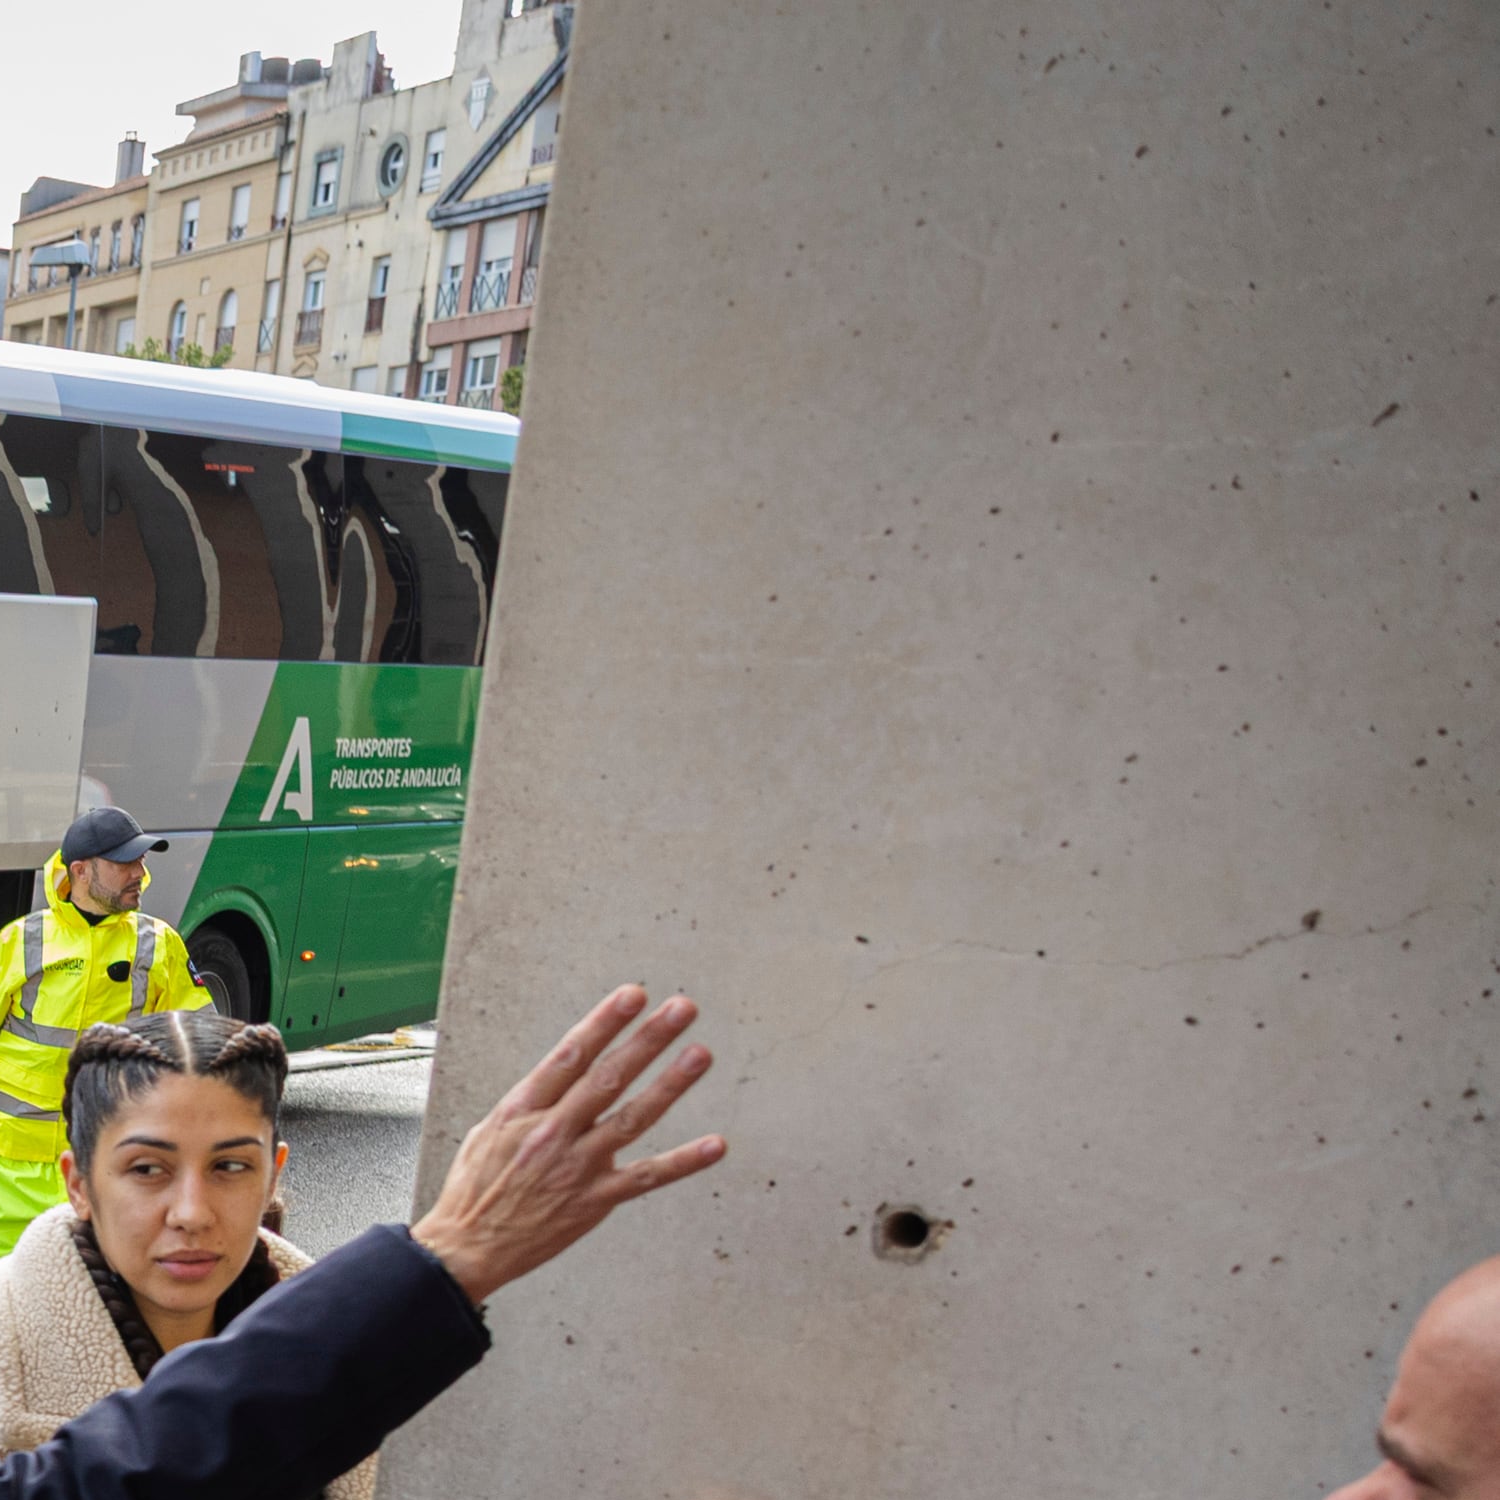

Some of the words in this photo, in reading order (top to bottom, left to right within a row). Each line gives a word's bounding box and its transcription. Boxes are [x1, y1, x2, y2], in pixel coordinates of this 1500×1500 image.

[335, 738, 413, 758] TRANSPORTES
[330, 764, 384, 789] PÚBLICOS
[385, 768, 400, 788] DE
[401, 763, 462, 788] ANDALUCÍA
